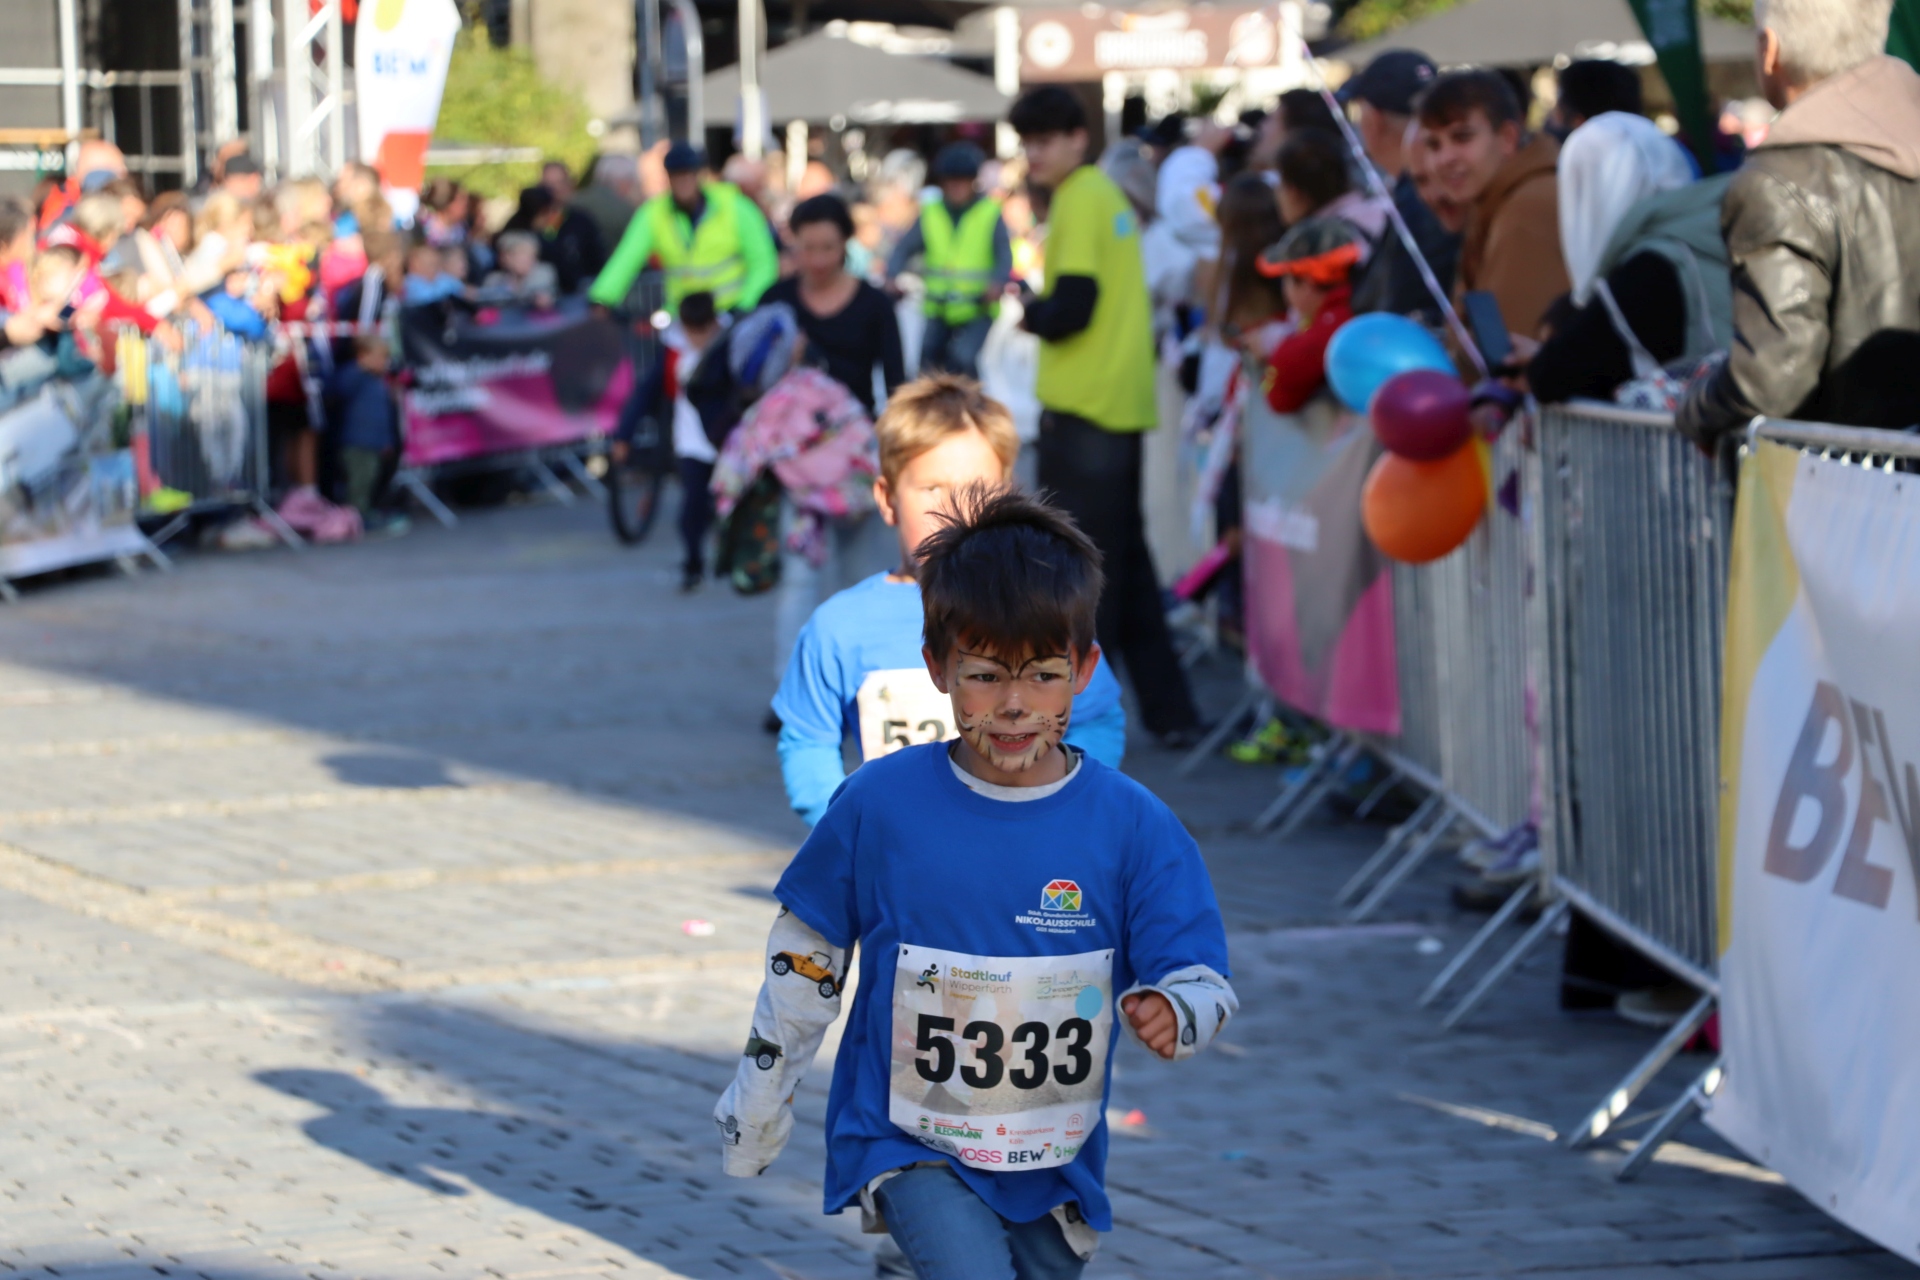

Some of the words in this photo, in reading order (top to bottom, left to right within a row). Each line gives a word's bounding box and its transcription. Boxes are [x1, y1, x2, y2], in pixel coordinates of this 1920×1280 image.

[1015, 915, 1096, 927] NIKOLAUSSCHULE
[950, 966, 1012, 982] Stadtlauf
[950, 980, 1013, 994] Wipperfürth
[915, 1013, 1093, 1090] 5333
[934, 1125, 982, 1140] BLECHMANN
[954, 1144, 1003, 1164] VOSS
[1007, 1148, 1046, 1164] BEW
